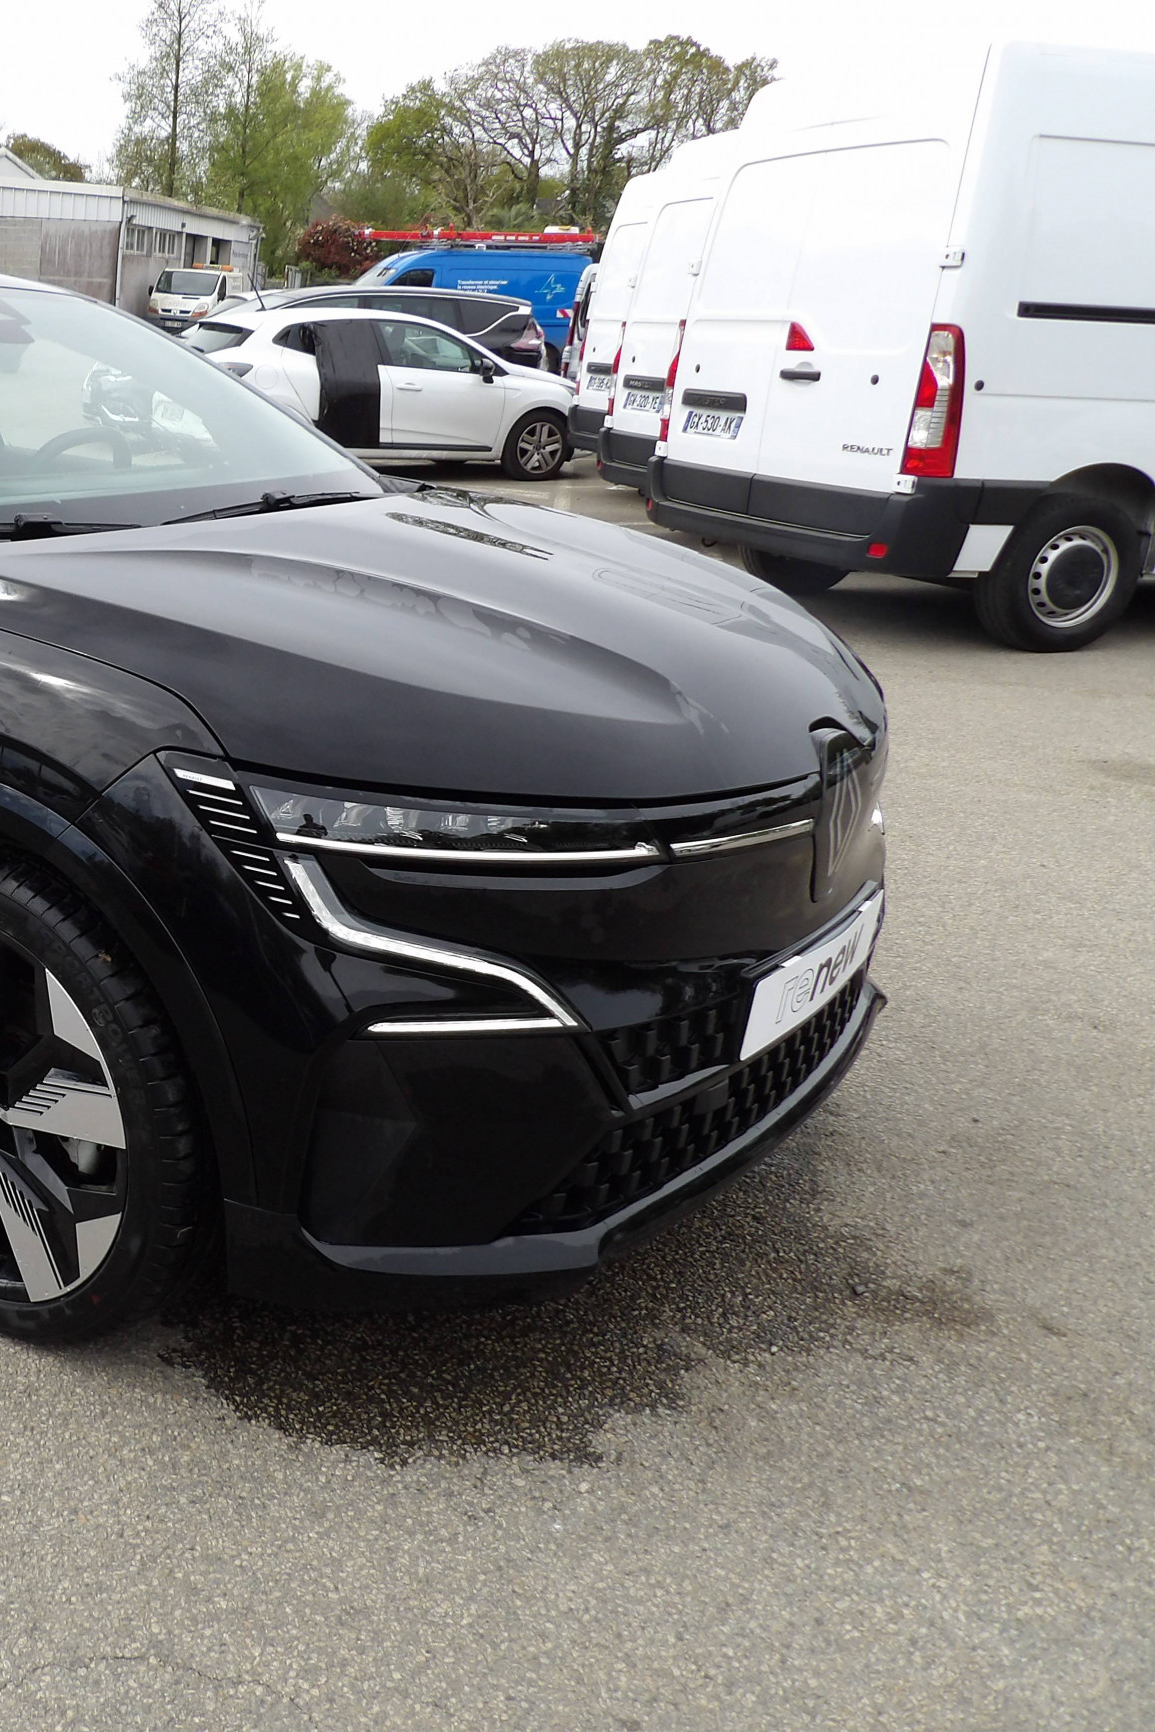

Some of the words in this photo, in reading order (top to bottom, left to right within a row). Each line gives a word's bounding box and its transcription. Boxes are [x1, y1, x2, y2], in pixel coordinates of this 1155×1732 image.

[689, 413, 735, 434] GX-530-AK
[842, 443, 894, 456] RENAULT
[775, 922, 865, 1025] renew
